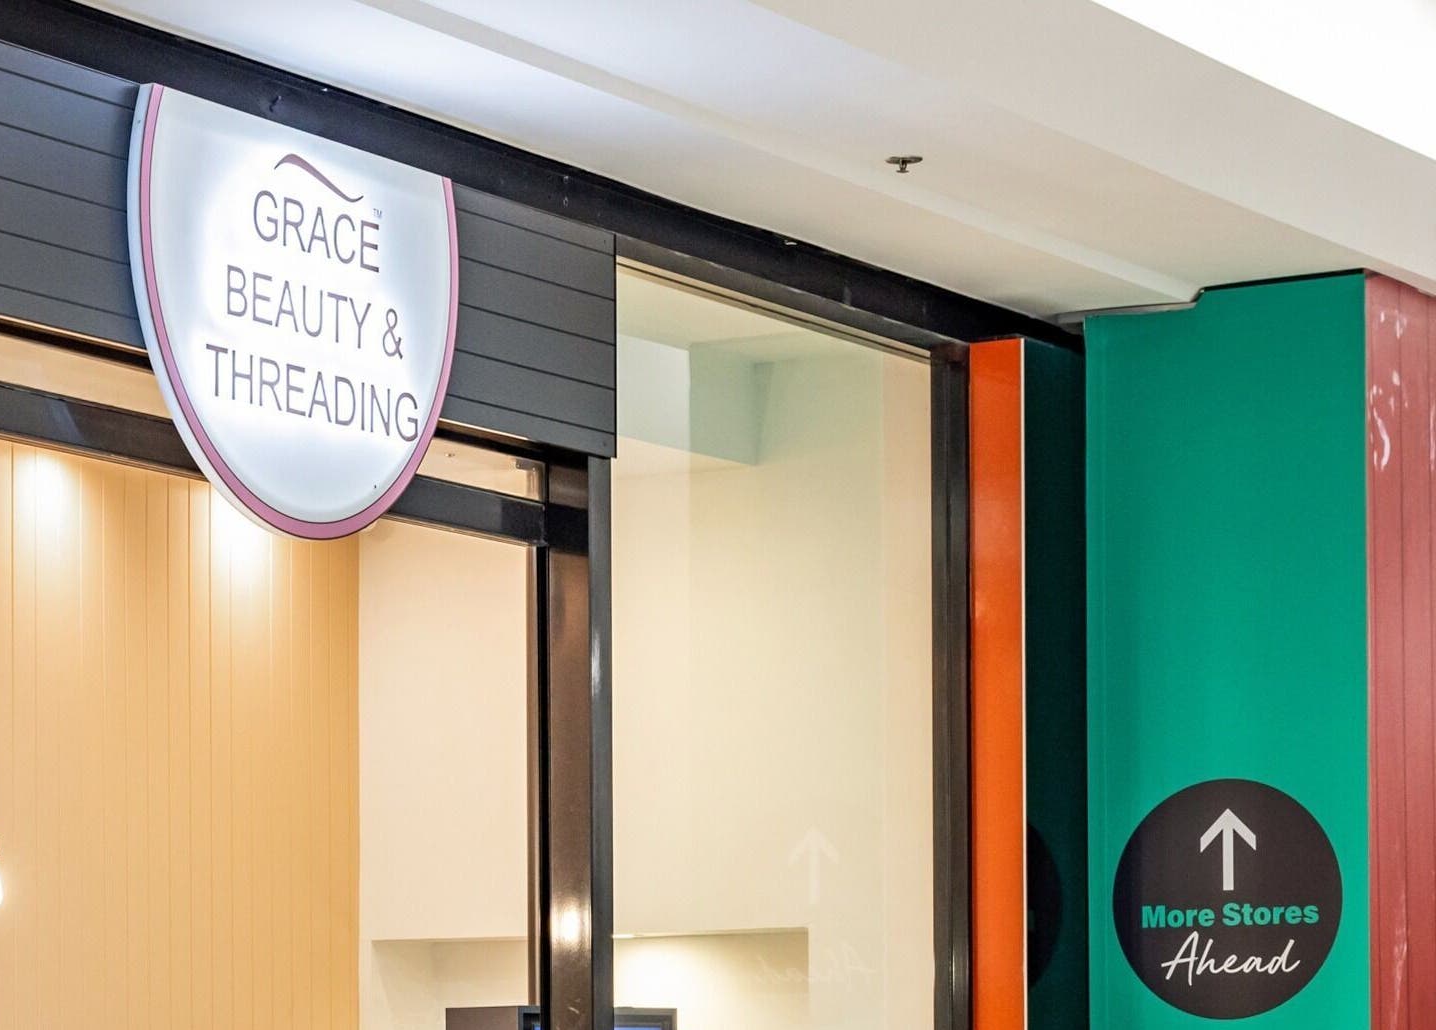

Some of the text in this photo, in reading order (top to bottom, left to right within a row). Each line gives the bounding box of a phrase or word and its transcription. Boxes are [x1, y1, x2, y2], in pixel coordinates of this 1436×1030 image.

[253, 190, 380, 273] GRACE
[226, 264, 403, 360] BEAUTY &
[205, 343, 419, 442] THREADING
[1141, 903, 1319, 928] More Stores
[1161, 930, 1301, 986] Ahead
